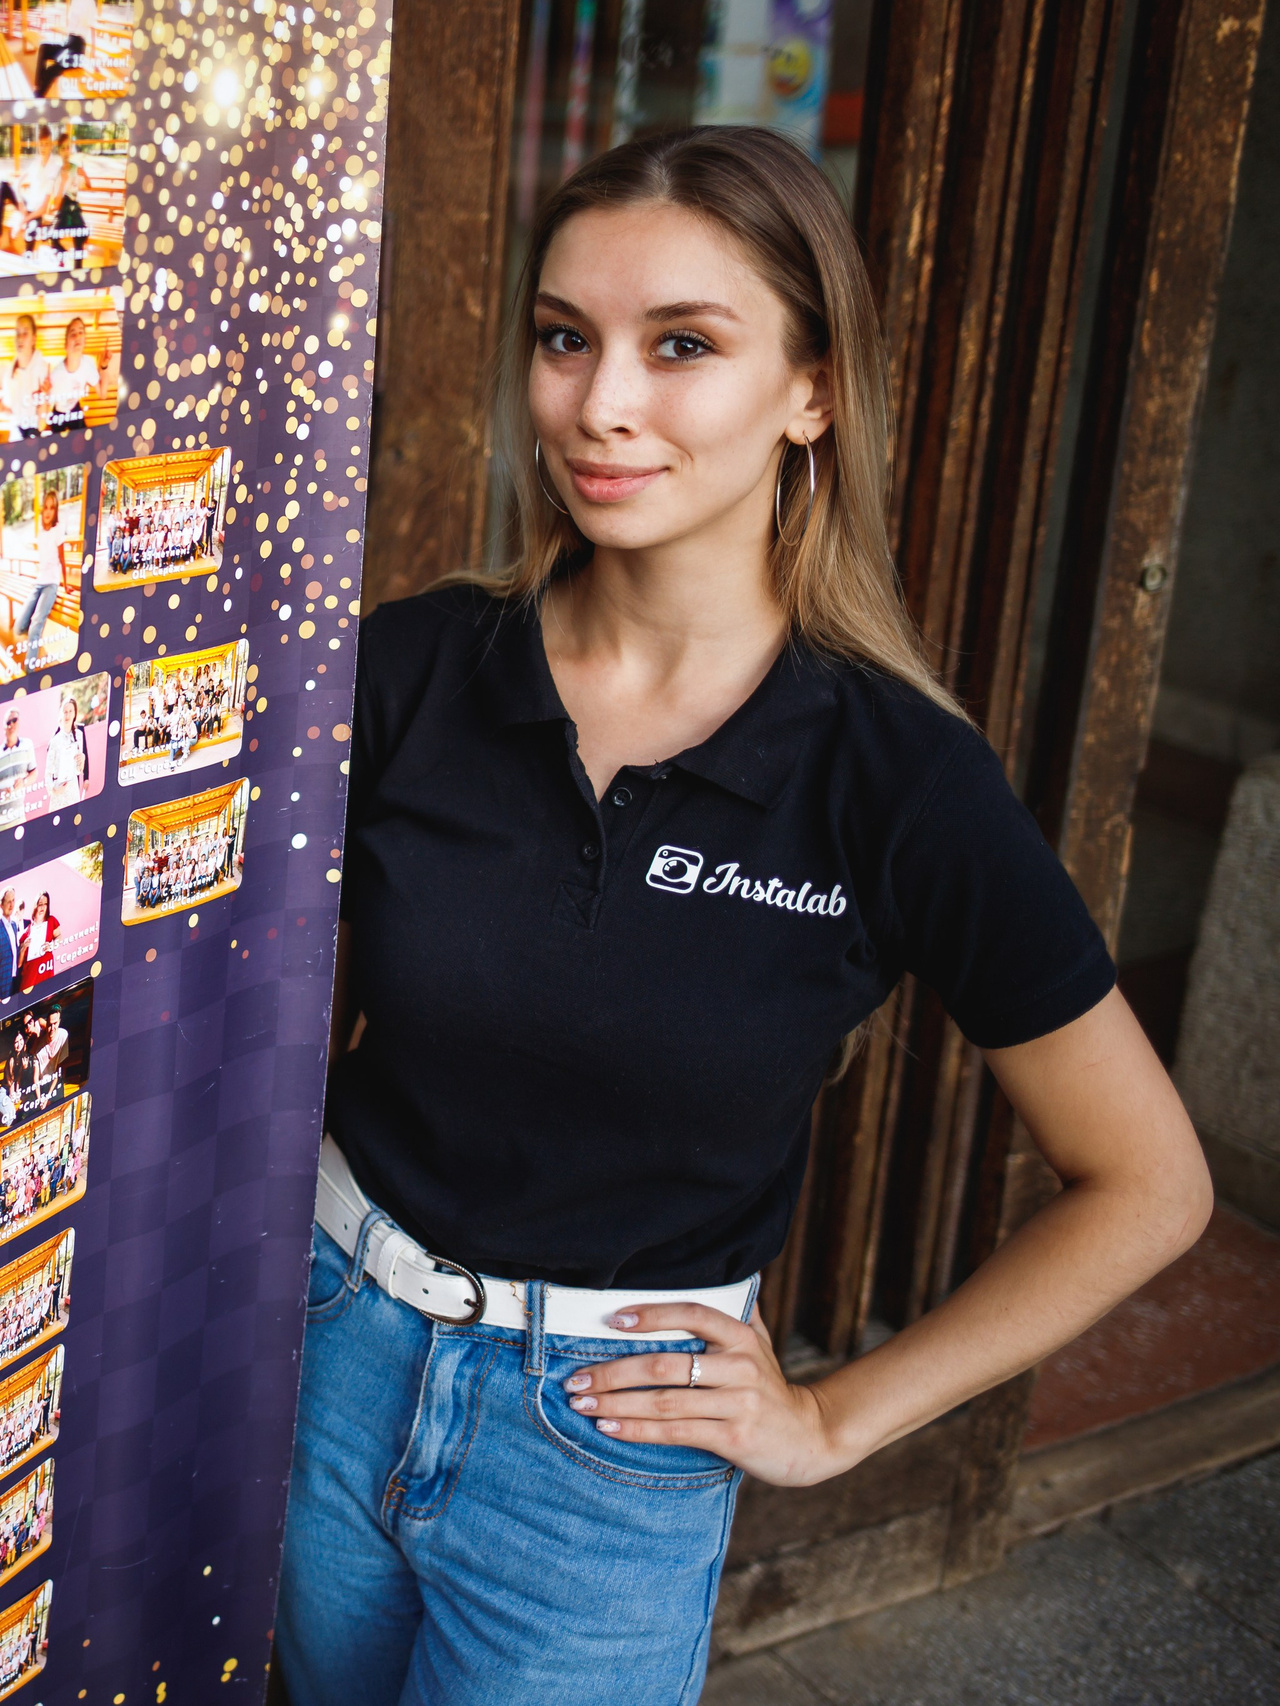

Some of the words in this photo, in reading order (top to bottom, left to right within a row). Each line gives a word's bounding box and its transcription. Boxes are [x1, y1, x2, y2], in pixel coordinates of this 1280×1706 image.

[132, 569, 146, 580] ОЦ
[702, 862, 847, 917] Instalab
[161, 900, 174, 912] ОЦ
[38, 960, 53, 974] ОЦ
